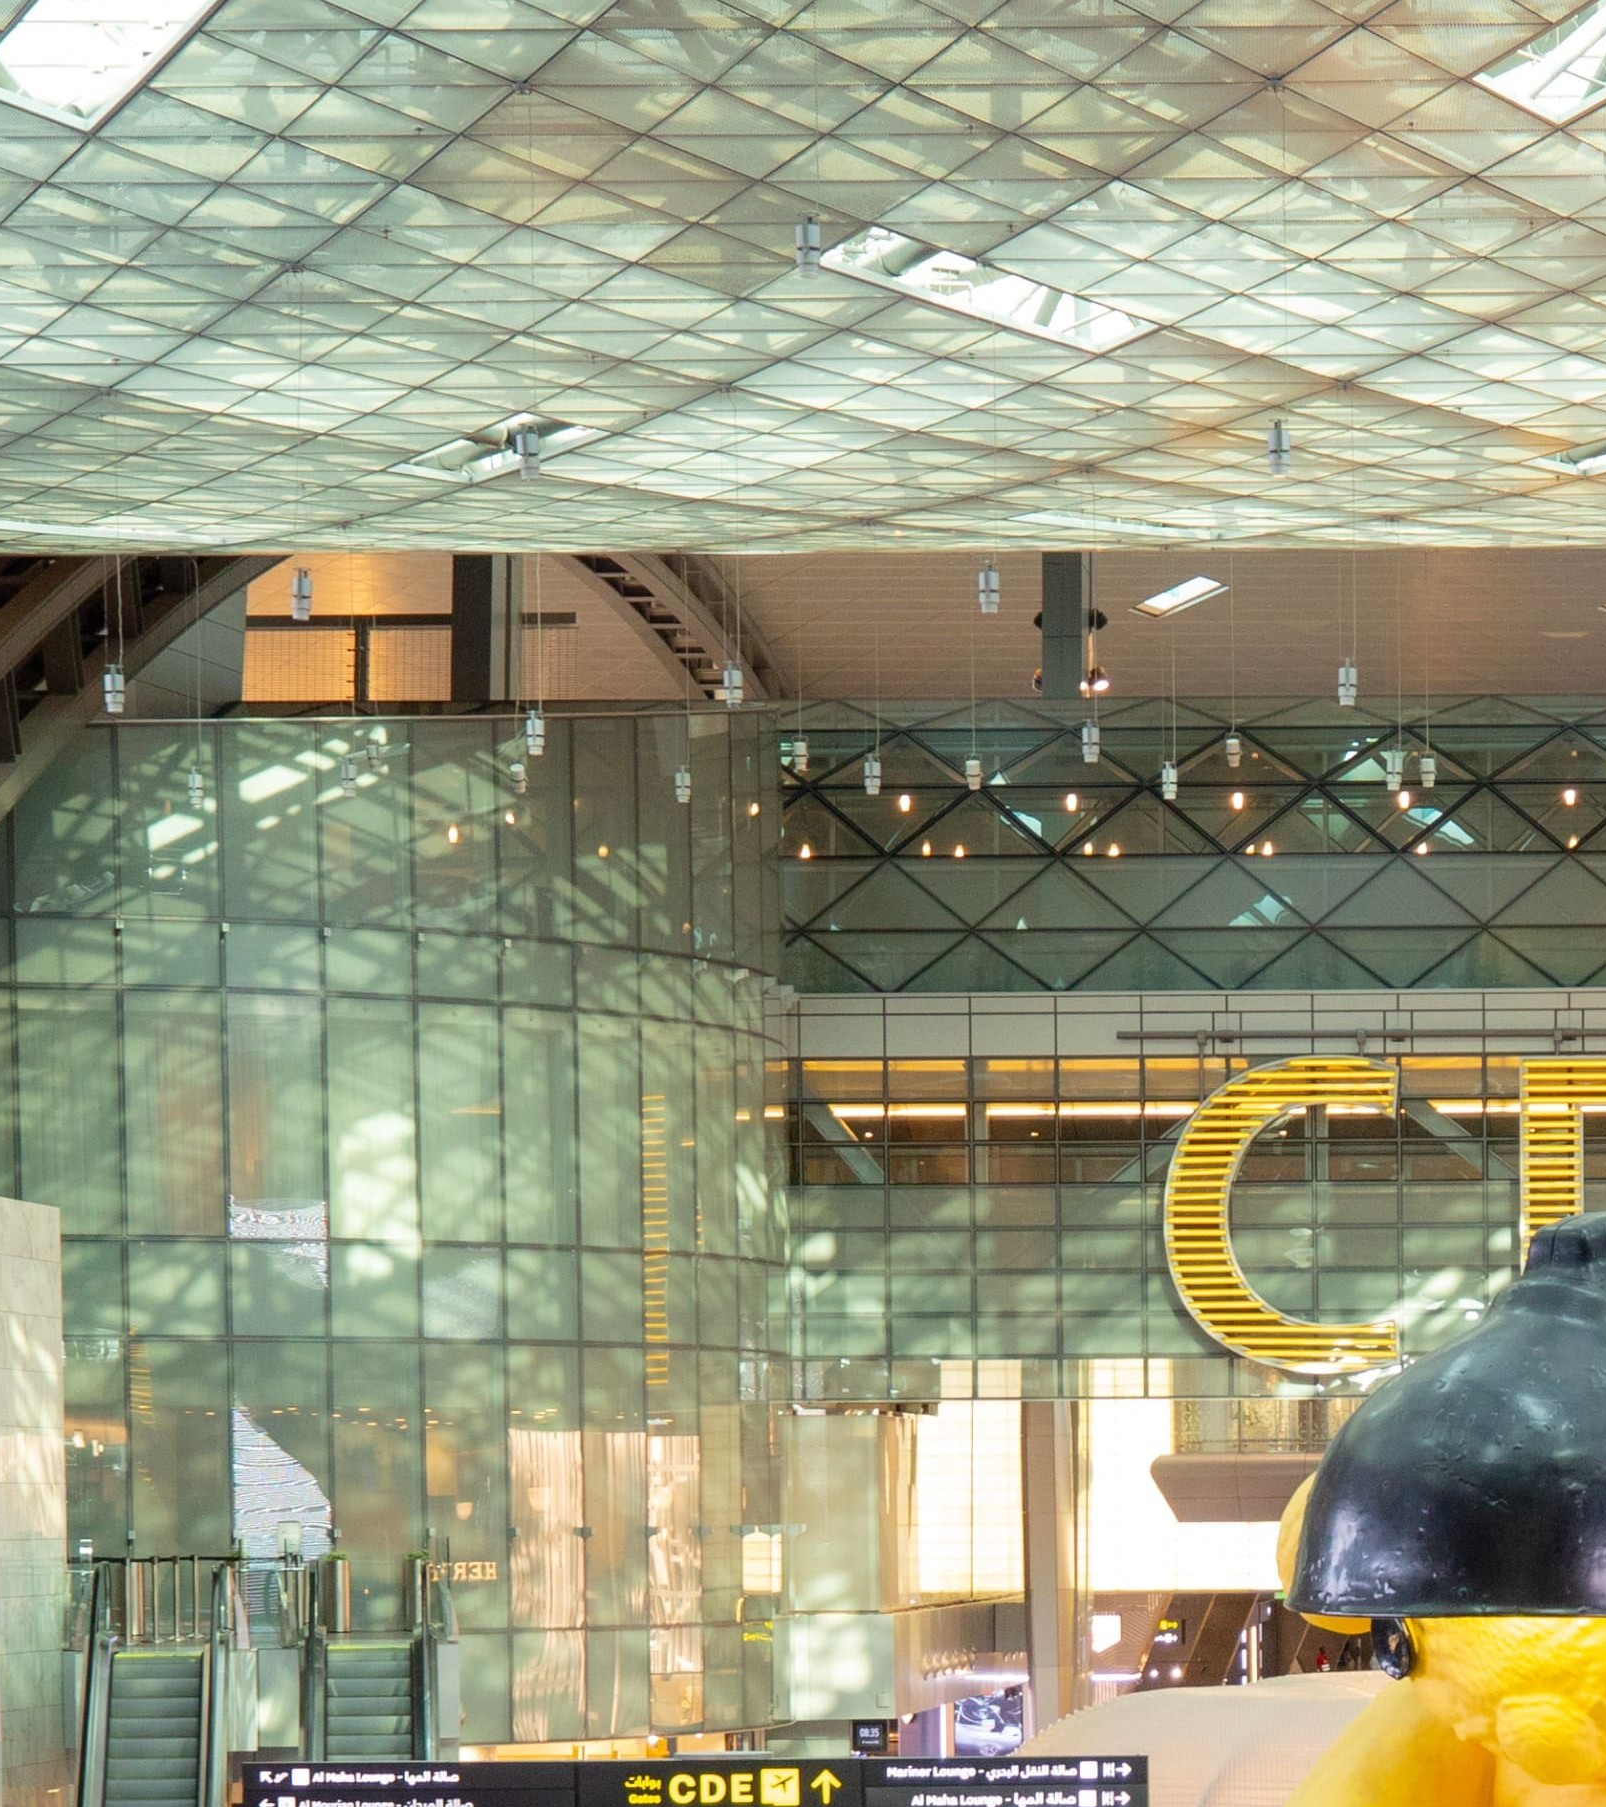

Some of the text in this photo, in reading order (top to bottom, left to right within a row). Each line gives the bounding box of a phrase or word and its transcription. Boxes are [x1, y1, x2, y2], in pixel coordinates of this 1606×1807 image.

[933, 1764, 976, 1781] Lounge
[1019, 1764, 1048, 1779] النقل
[1050, 1764, 1078, 1776] صالة
[312, 1771, 324, 1783] Al
[355, 1771, 395, 1786] Lounge
[668, 1773, 755, 1805] CDE
[910, 1792, 923, 1806] Al
[1046, 1792, 1077, 1805] صالة
